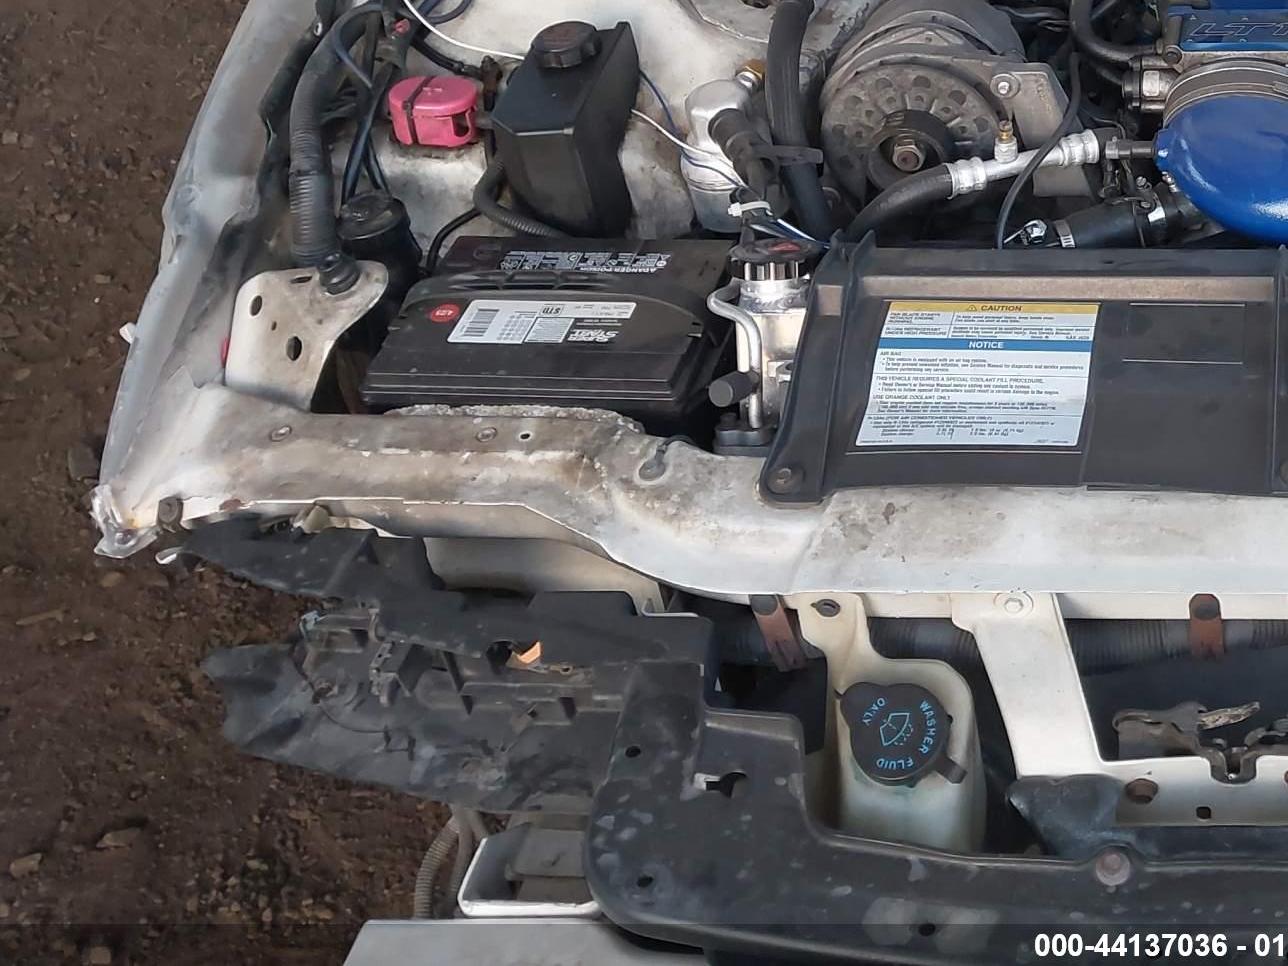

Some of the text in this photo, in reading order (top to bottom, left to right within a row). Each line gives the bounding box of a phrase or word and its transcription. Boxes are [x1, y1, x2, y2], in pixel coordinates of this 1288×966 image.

[862, 698, 937, 770] WASHER FLUID ONLY
